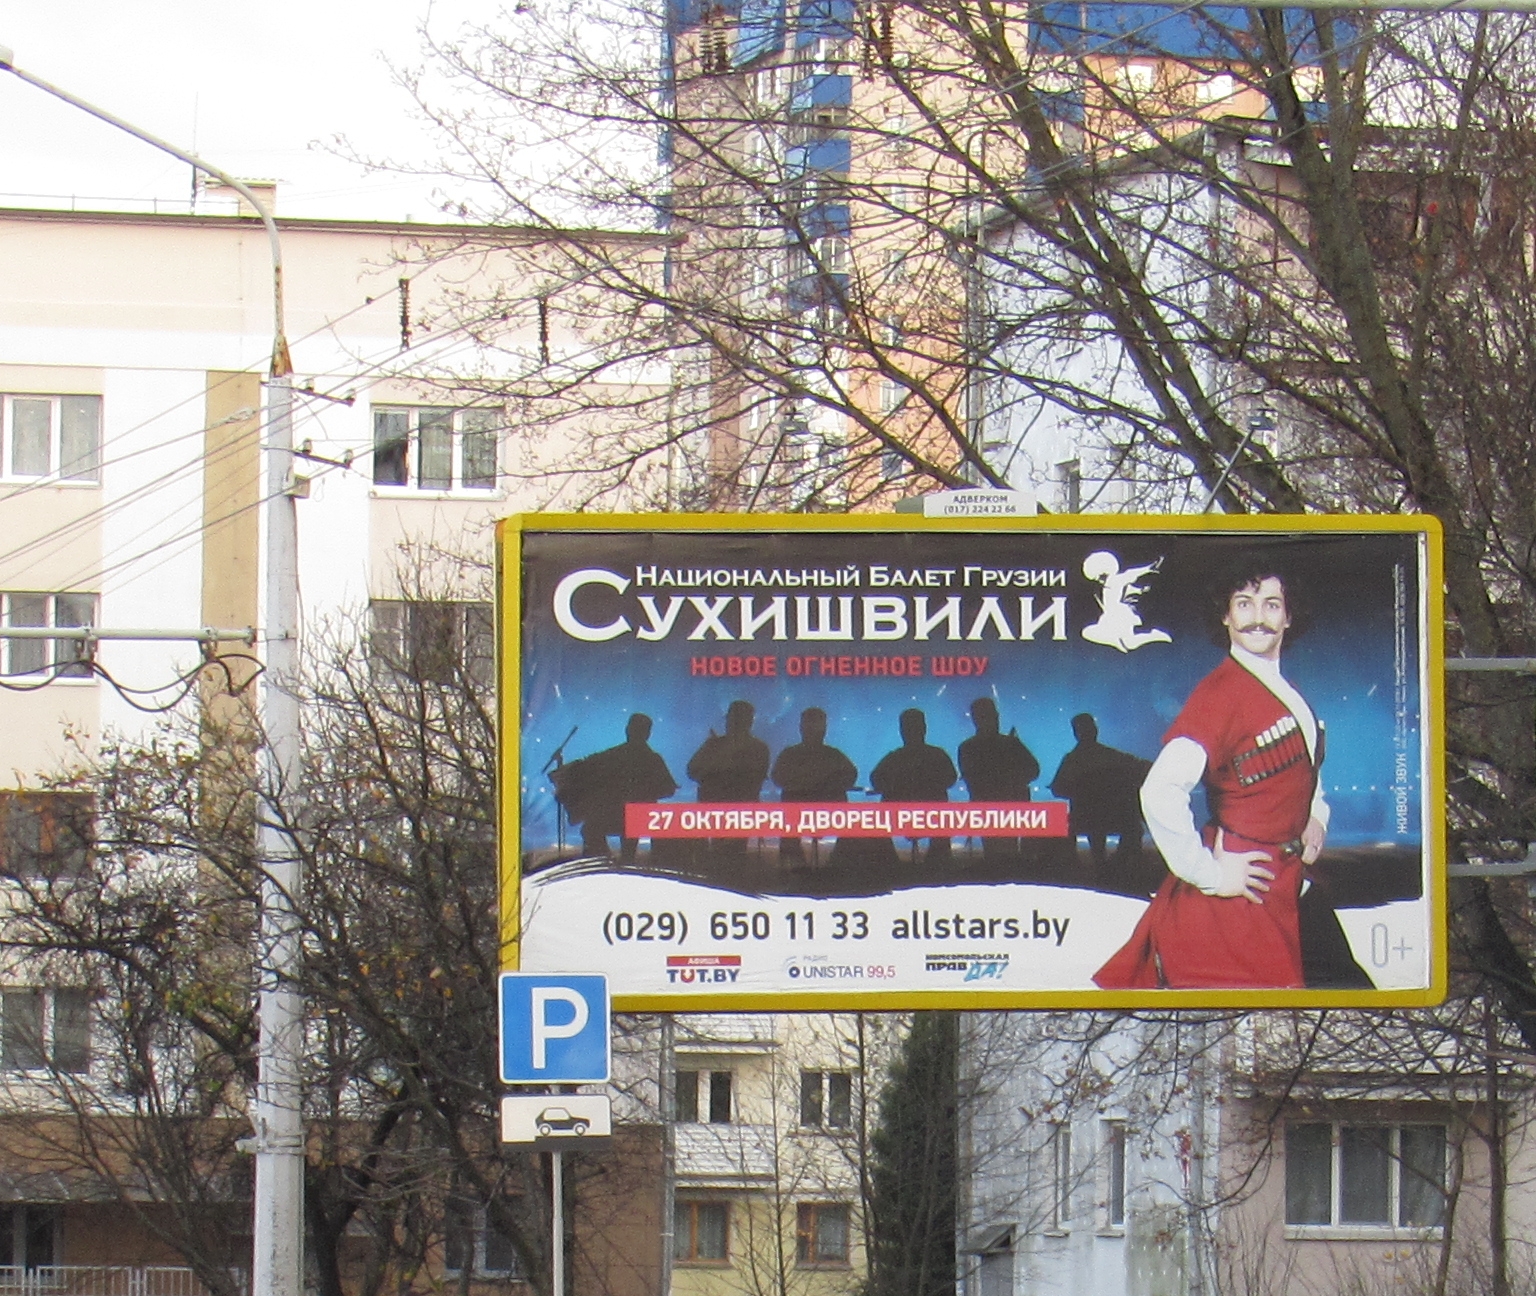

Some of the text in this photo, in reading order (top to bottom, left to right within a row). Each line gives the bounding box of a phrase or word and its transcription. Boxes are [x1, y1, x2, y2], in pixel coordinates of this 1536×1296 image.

[944, 505, 970, 514] (017)
[972, 505, 989, 513] 224
[991, 505, 1003, 513] 22
[953, 495, 1008, 504] АДВЕРКОМ
[552, 567, 1068, 641] СУХИШВИЛИ
[690, 656, 989, 677] НОВОЕ ОГНЕННОЕ ШОУ
[1396, 752, 1407, 783] ЗВУК
[648, 809, 1048, 833] 27 ОКТЯБРЯ, ДВОРЕЦ РЕСПУБЛИКИ
[1396, 784, 1408, 835] ЖИВОЙ
[602, 909, 1071, 946] (029) 650 11 33 allstars.by
[1371, 922, 1414, 969] 0+
[666, 968, 740, 983] TUT.BY
[802, 965, 896, 979] UNISTAR 99,5
[531, 986, 589, 1070] P
